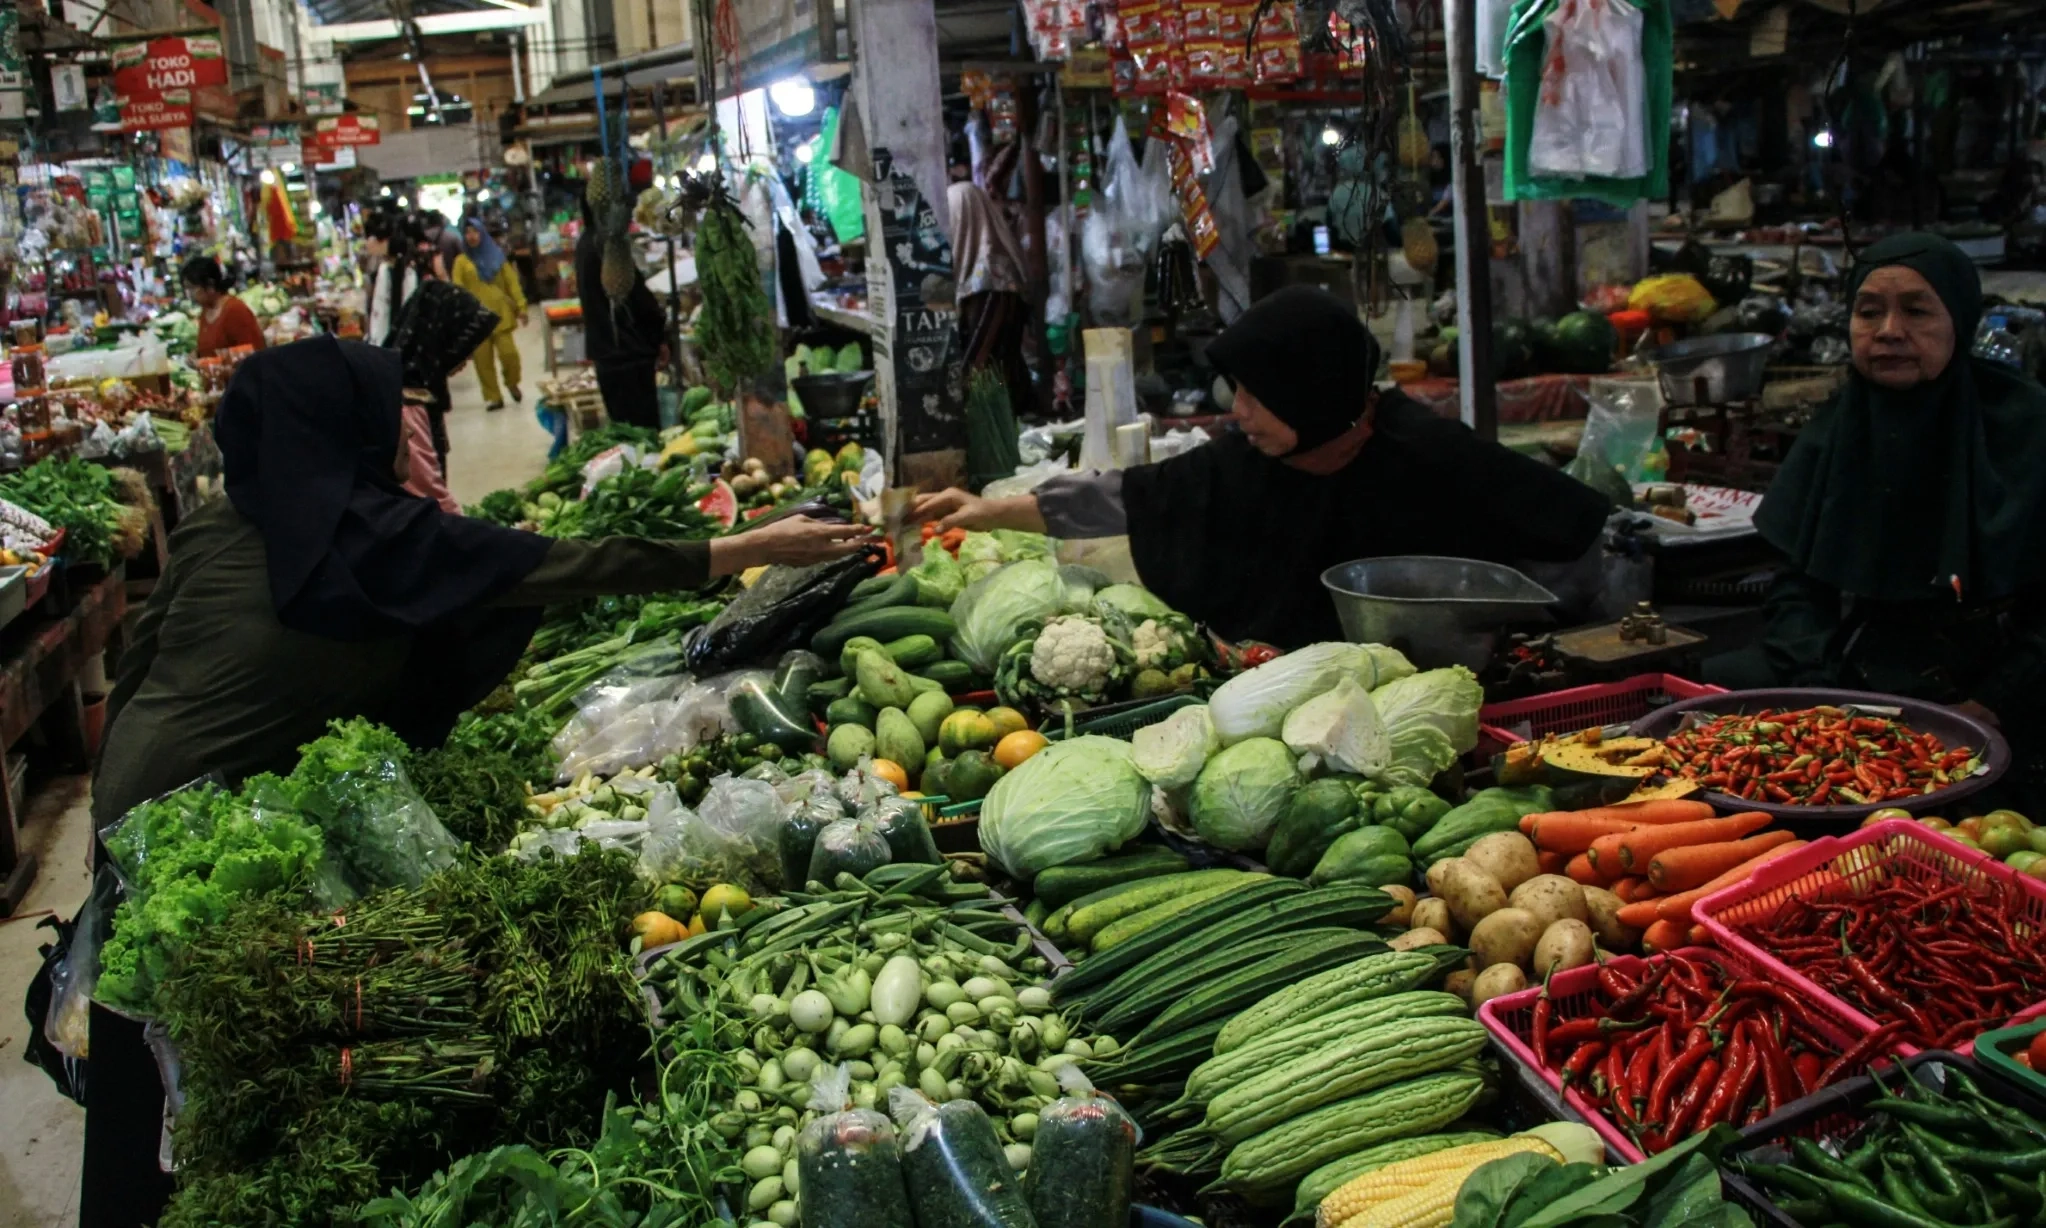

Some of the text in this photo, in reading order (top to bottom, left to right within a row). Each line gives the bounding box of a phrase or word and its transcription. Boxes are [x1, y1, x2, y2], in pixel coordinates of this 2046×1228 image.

[148, 55, 191, 70] TOKO
[146, 69, 196, 89] HADI
[130, 102, 164, 114] TOKO
